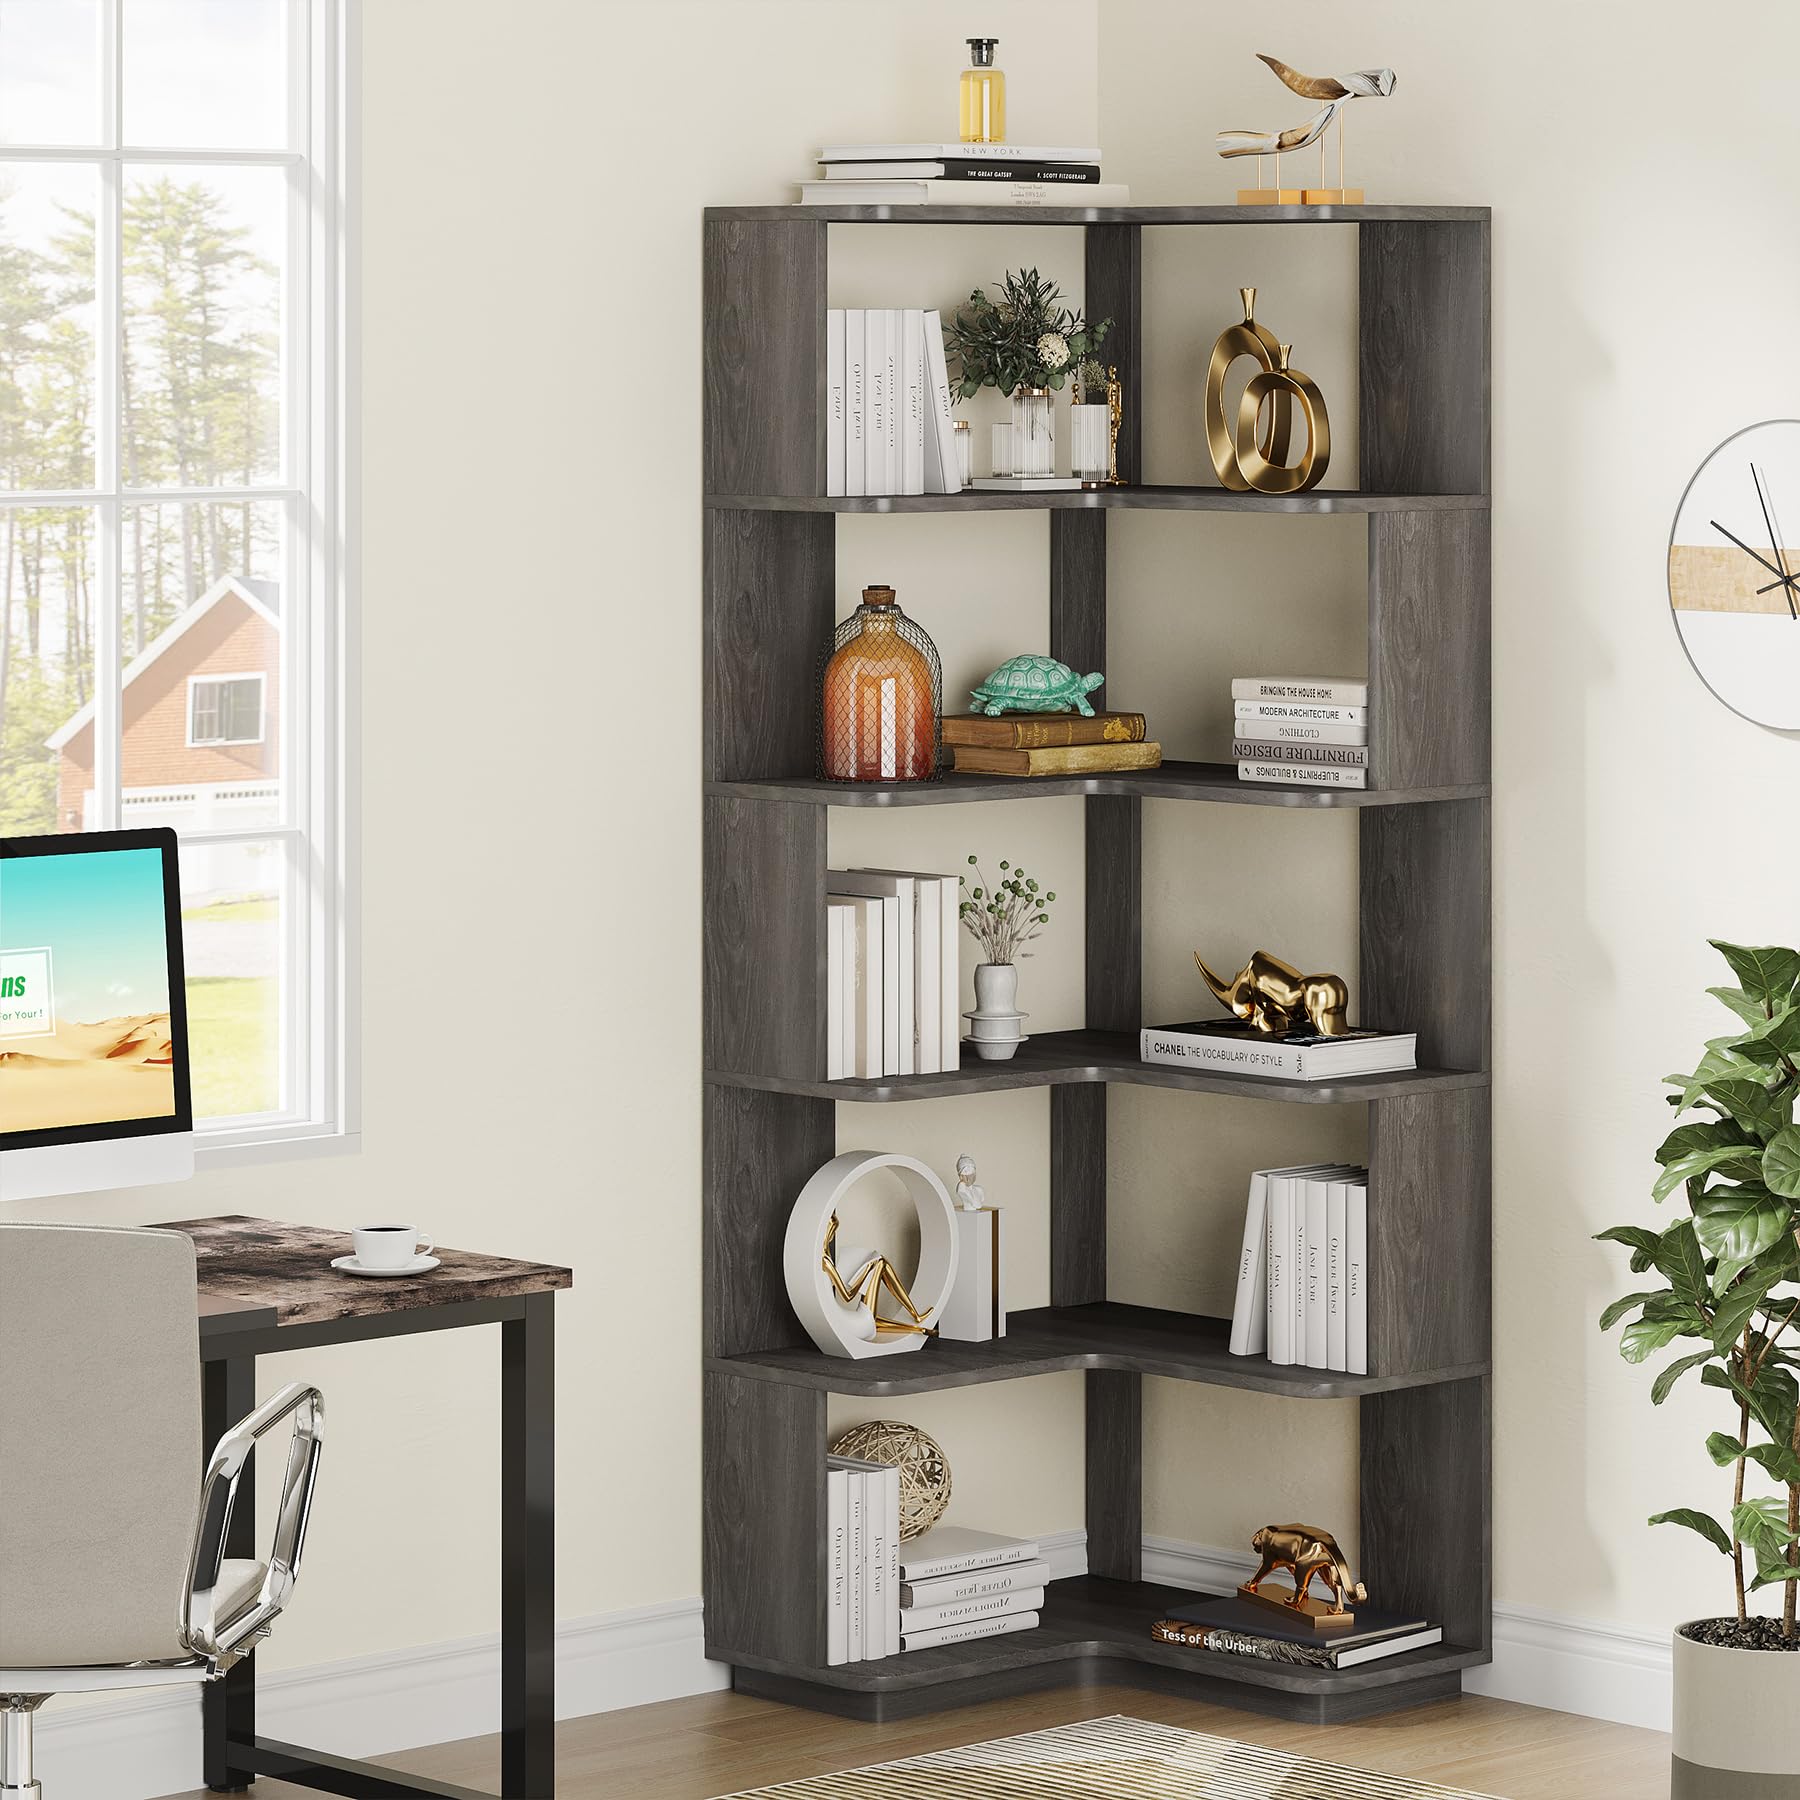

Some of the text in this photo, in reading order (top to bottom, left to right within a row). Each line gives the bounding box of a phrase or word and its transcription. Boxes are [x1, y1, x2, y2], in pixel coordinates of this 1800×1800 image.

[963, 147, 1022, 156] NEW YORK
[967, 170, 1012, 179] THE GREAT GATSBY
[1058, 172, 1087, 180] FITZGERALD
[1260, 685, 1332, 699] BRINGING THE HOUSE HOME
[1259, 706, 1288, 717] MODERN
[1288, 708, 1340, 720] ARCHITECTURE
[1279, 727, 1320, 739] CLOTHING
[1234, 743, 1364, 764] FURNITURE DESIGN
[1255, 766, 1291, 779] BUILDINGS
[1292, 770, 1298, 779] &
[1298, 769, 1340, 782] BLUEPRINTS
[1, 975, 26, 998] ns
[15, 1011, 37, 1019] Your
[1154, 1042, 1283, 1067] CHANEL THE VOCABULARY OF STYLE
[1161, 1628, 1258, 1655] Tess of the Urber
